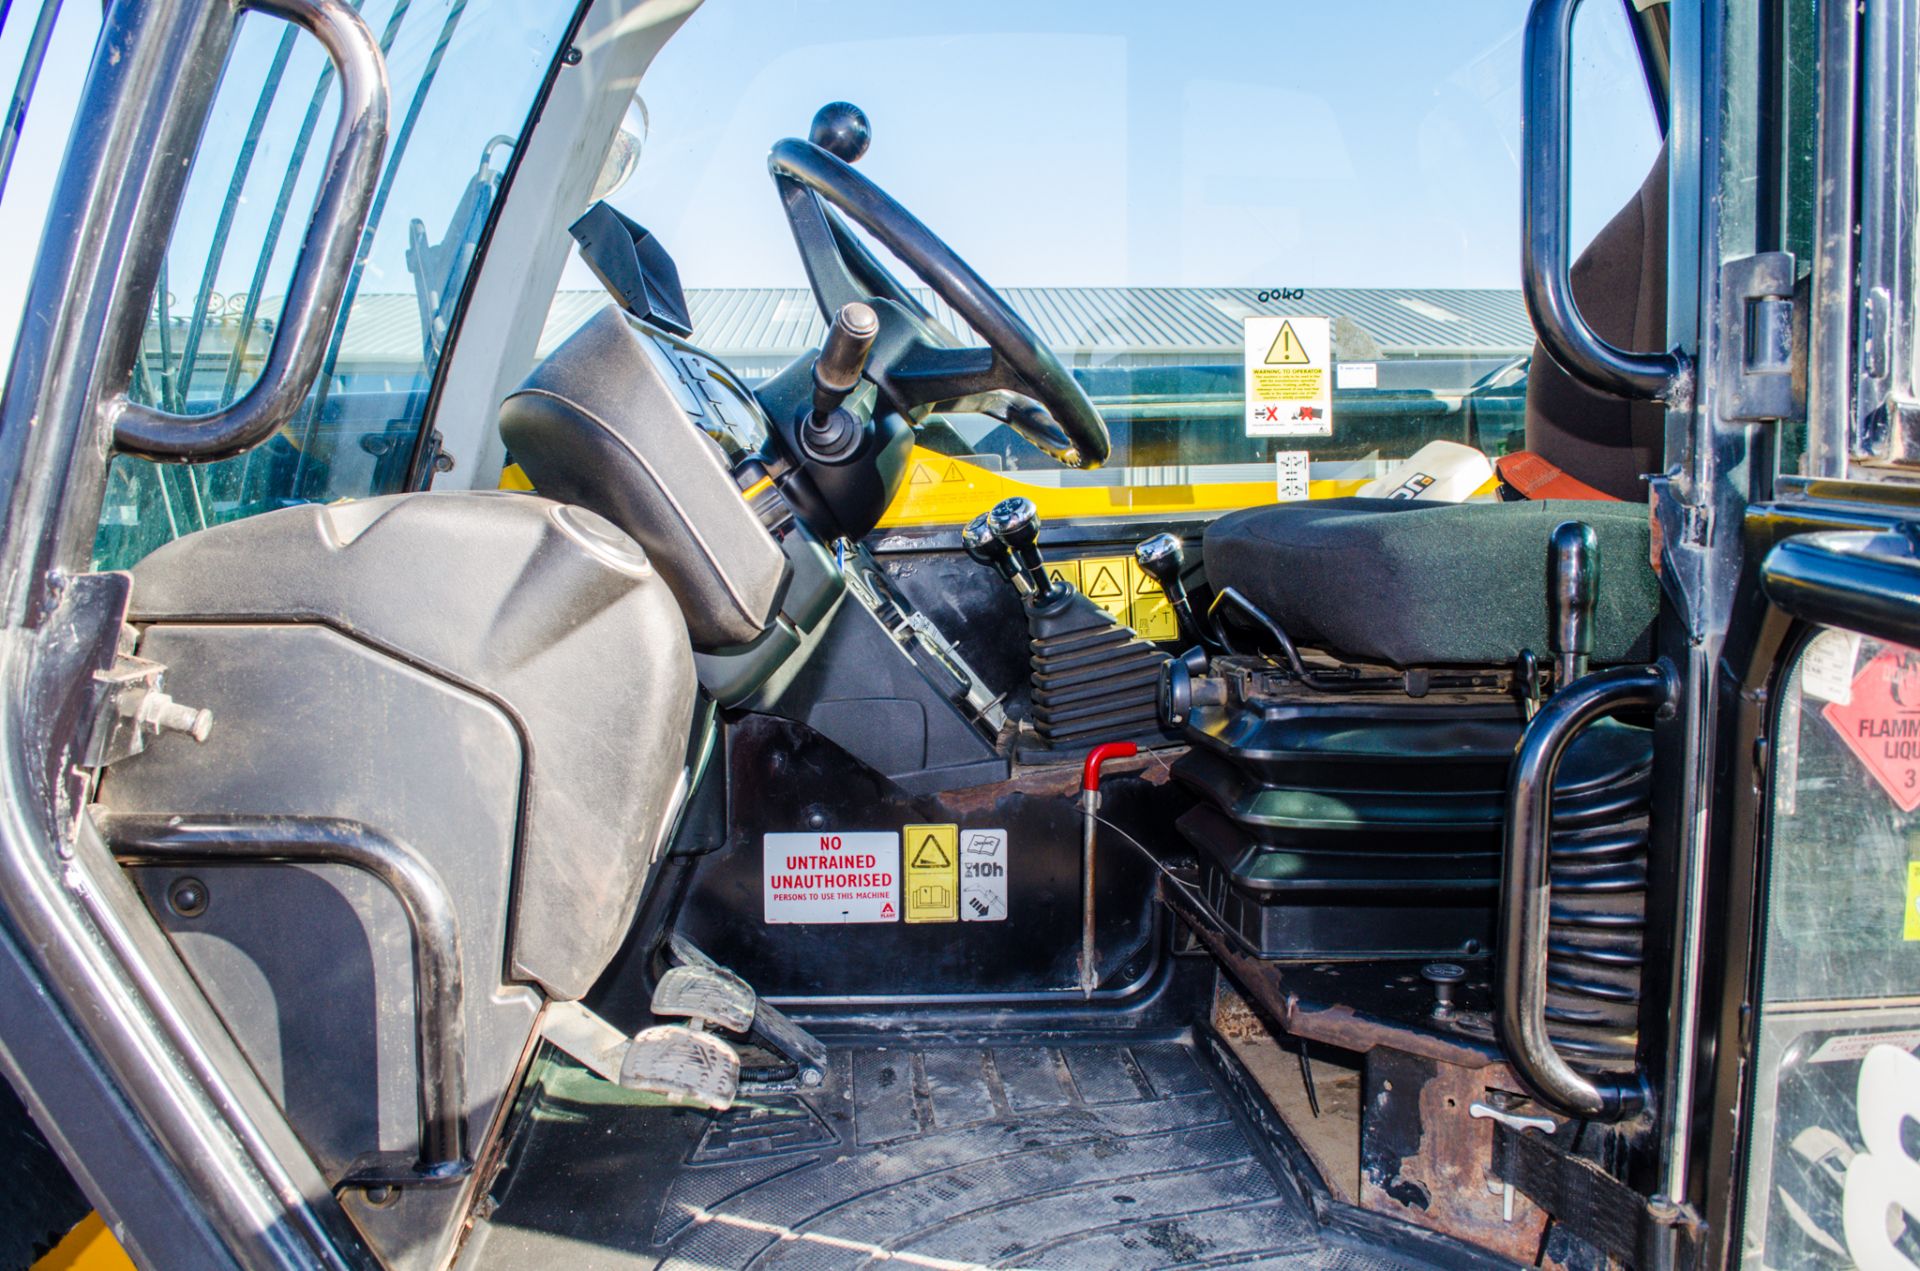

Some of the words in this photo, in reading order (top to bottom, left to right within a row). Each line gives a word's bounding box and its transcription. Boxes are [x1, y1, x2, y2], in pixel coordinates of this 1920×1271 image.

[1904, 768, 1916, 788] 3
[820, 836, 842, 851] NO
[786, 855, 876, 870] UNTRAINED
[973, 862, 1003, 877] 10h
[771, 873, 892, 889] UNAUTHORISED
[773, 893, 807, 901] PERSONS
[821, 892, 835, 900] USE
[837, 892, 853, 900] THIS
[856, 891, 890, 899] MACHINE
